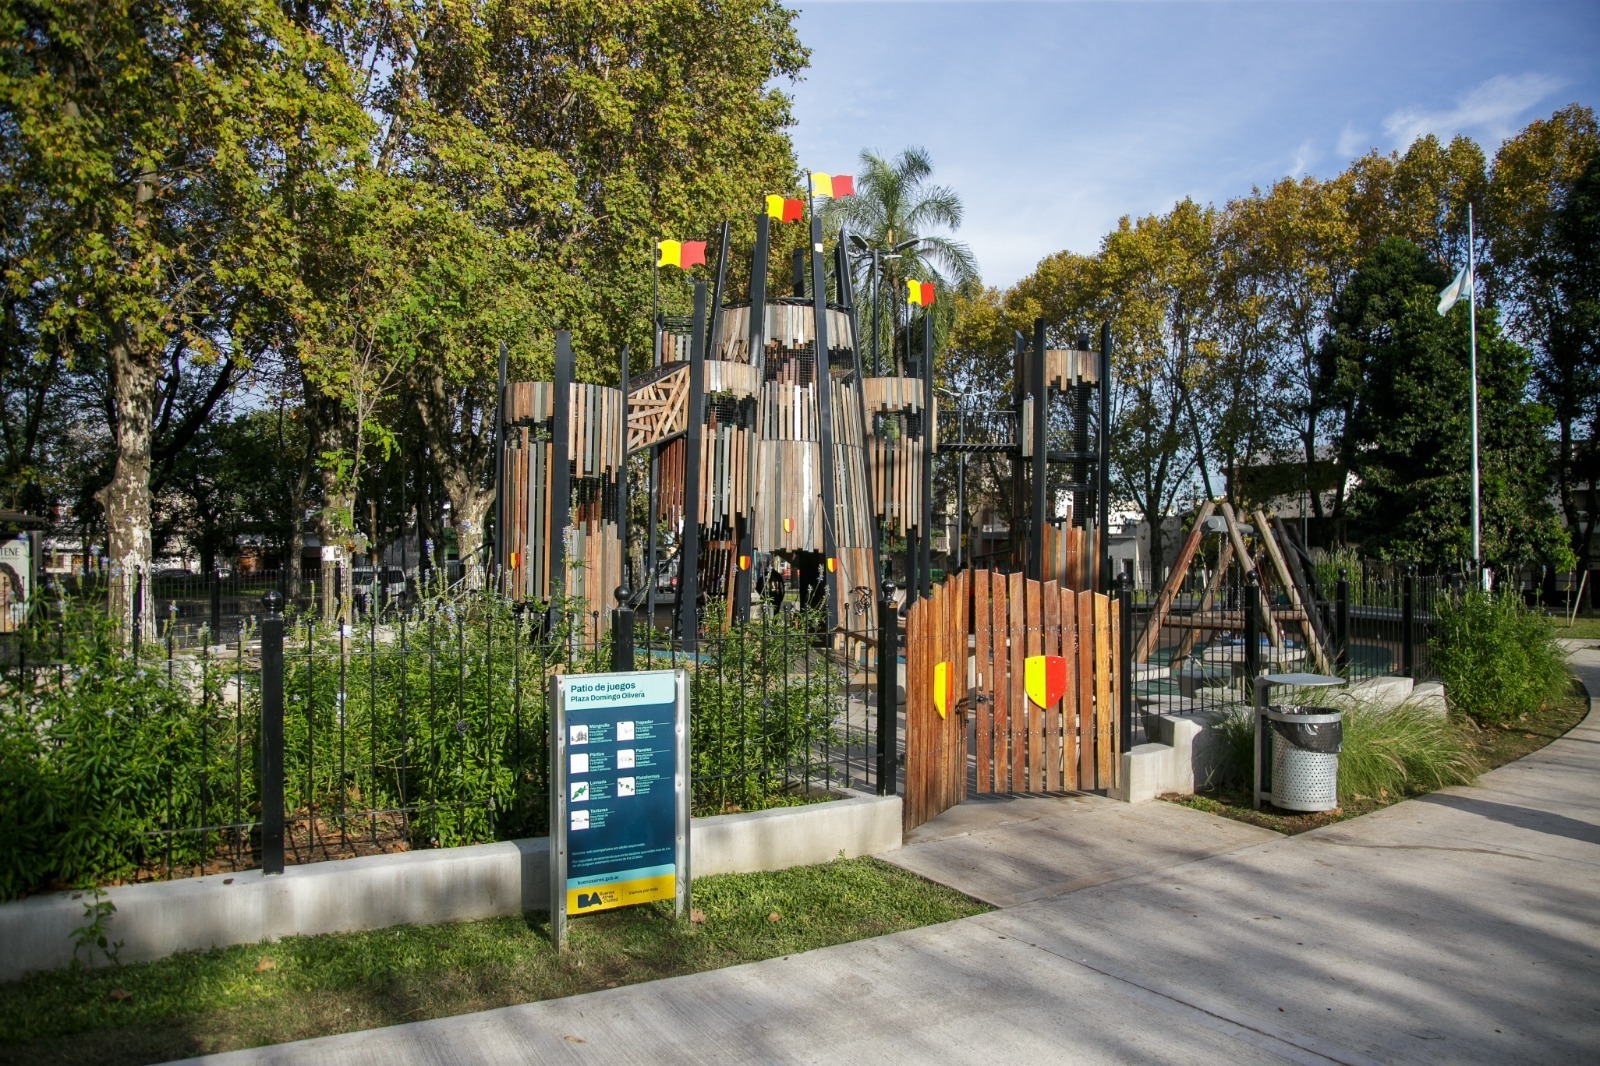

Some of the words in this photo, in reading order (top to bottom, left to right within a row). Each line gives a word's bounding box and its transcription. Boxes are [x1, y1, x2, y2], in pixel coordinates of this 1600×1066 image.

[570, 684, 593, 693] Patio
[594, 683, 606, 691] de
[607, 682, 636, 692] juegos
[590, 693, 620, 701] Domingo
[621, 691, 645, 699] Olivera
[577, 875, 620, 885] buenosaires.gob.ar
[577, 891, 602, 909] BA
